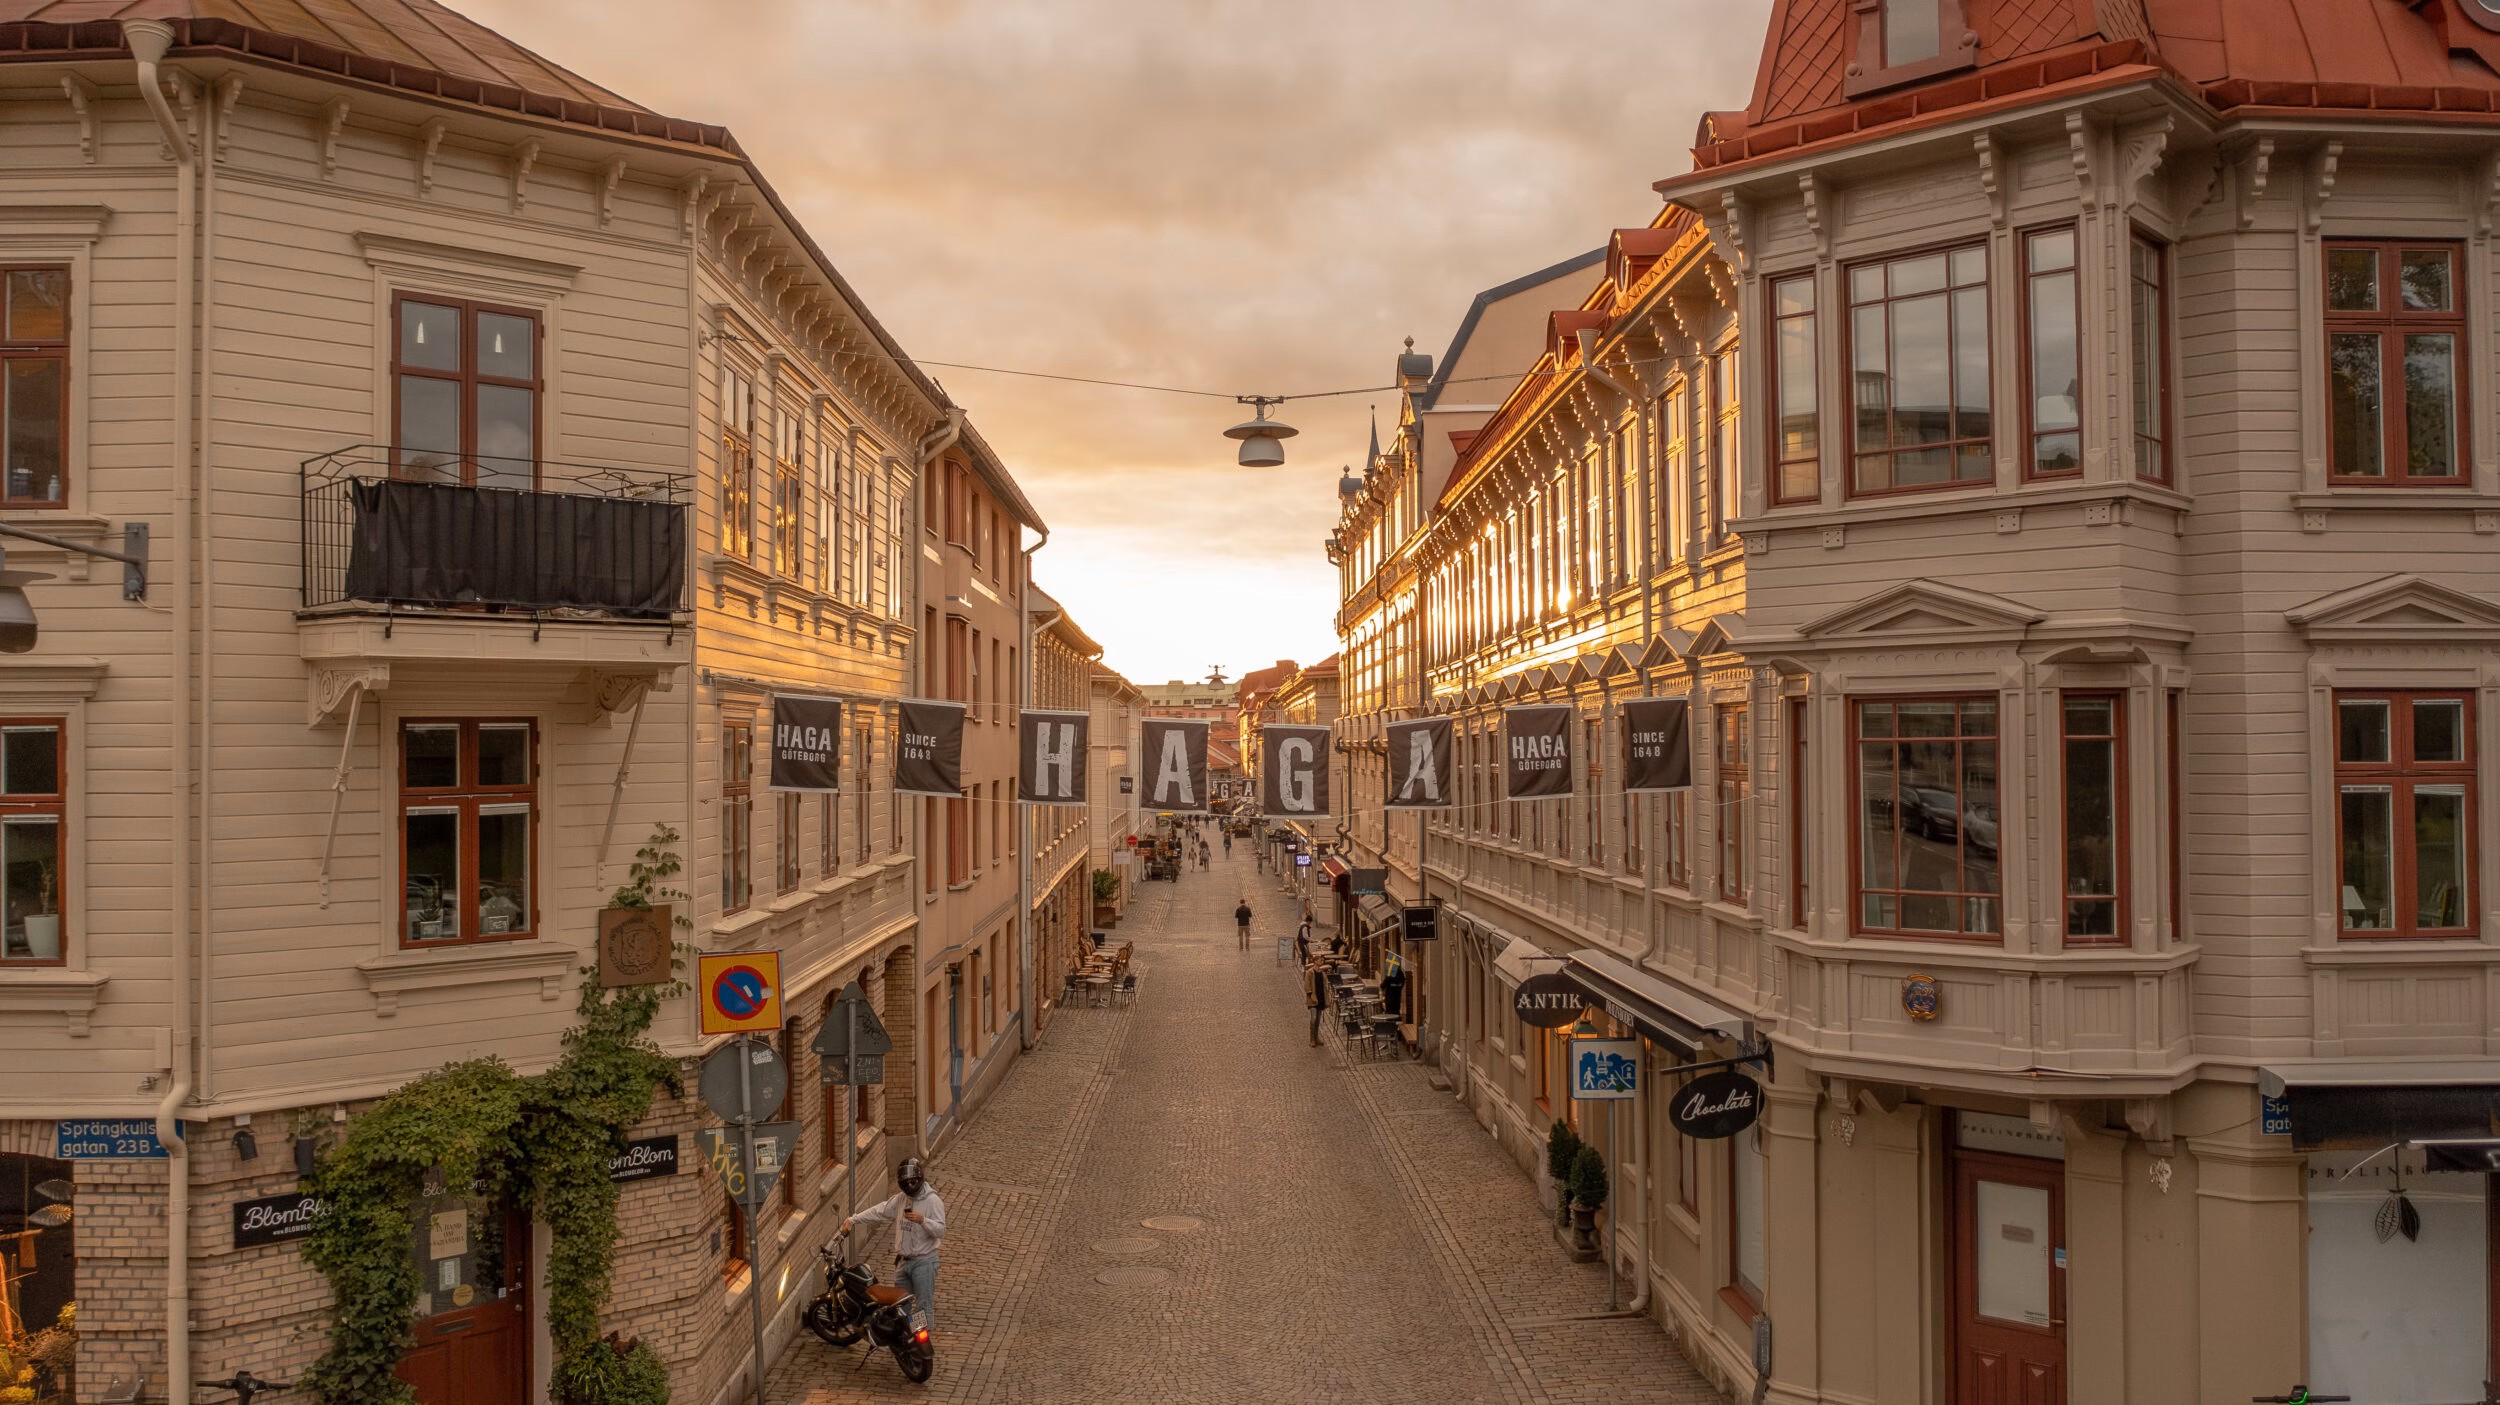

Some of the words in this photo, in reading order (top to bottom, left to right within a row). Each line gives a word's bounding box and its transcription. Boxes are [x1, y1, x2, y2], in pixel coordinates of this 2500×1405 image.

[776, 723, 832, 751] HAGA
[904, 732, 937, 748] SINCE
[1632, 731, 1665, 744] SINCE
[904, 747, 931, 760] 1648
[1511, 734, 1567, 759] HAGA
[1633, 746, 1661, 758] 1648
[781, 748, 826, 763] GÖTEBORG
[1518, 757, 1562, 771] GÖTEBORG
[1035, 721, 1076, 797] H
[1153, 729, 1195, 804] A
[1278, 737, 1315, 812] G
[1398, 729, 1441, 800] A
[1244, 781, 1253, 796] A
[1516, 993, 1584, 1010] ANTIK
[1681, 1088, 1752, 1121] Chocolate
[62, 1140, 108, 1156] gatan
[116, 1139, 150, 1154] 23B
[608, 1145, 674, 1170] omBlom
[241, 1198, 335, 1230] BlomBlo
